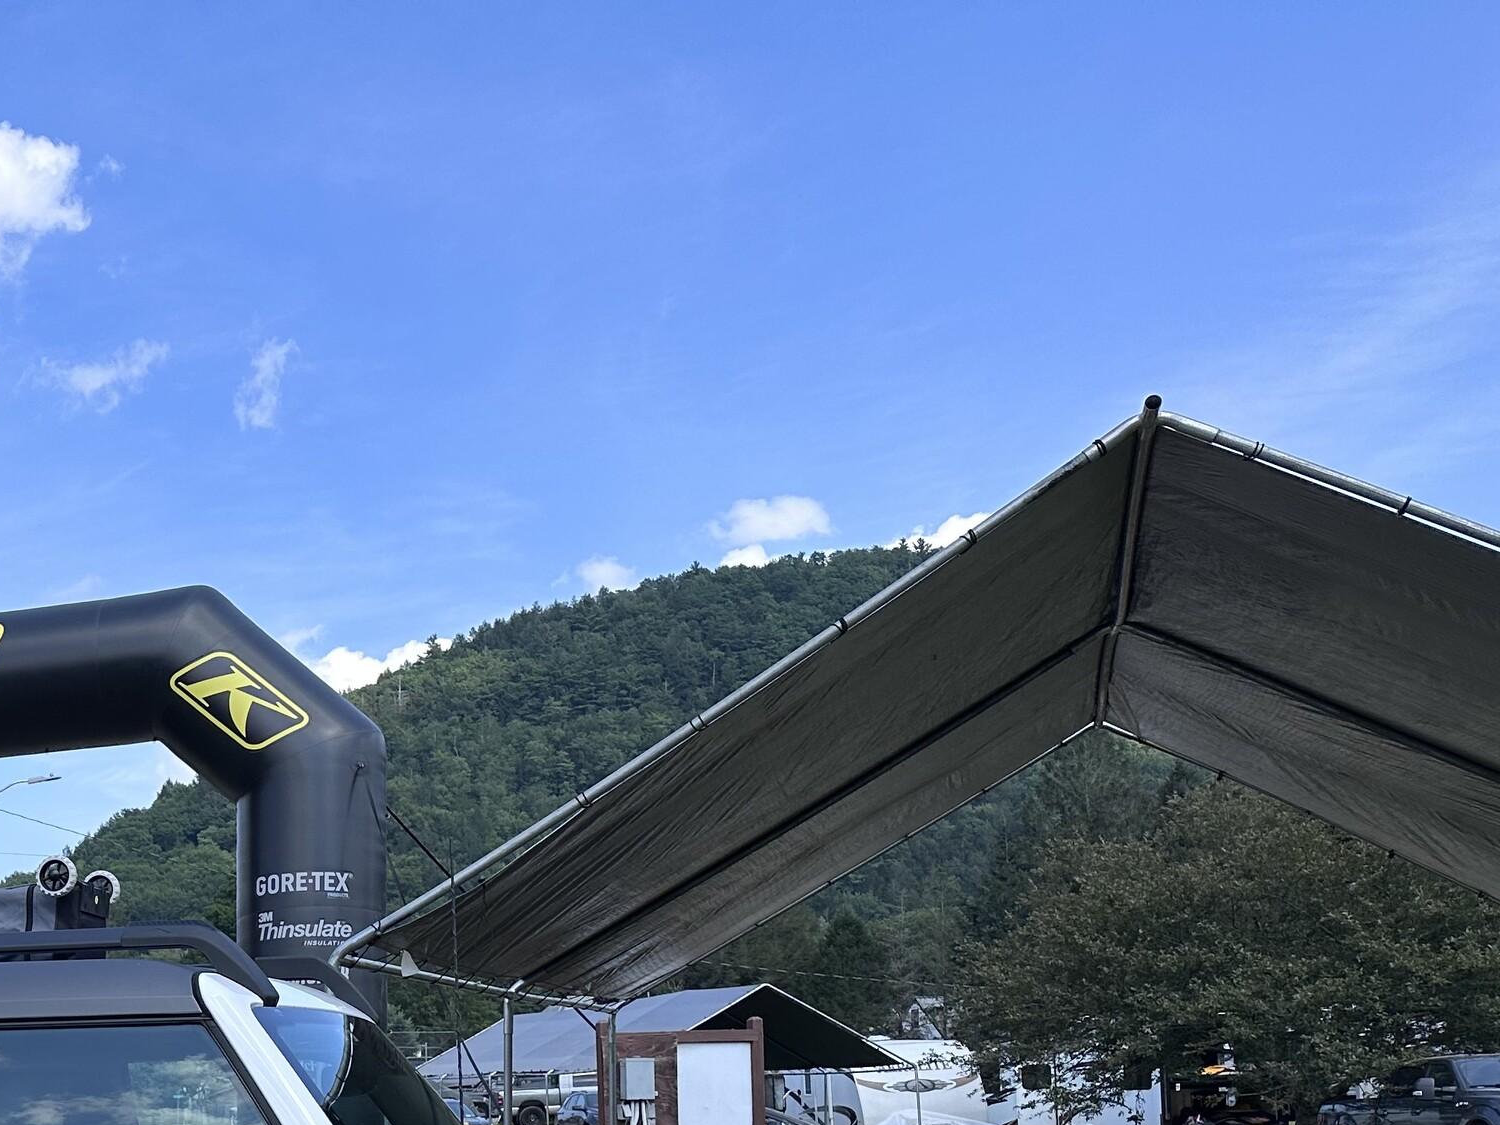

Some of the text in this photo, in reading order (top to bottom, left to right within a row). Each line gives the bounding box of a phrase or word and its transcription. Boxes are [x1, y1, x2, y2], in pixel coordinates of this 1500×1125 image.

[178, 665, 299, 737] K
[256, 871, 349, 896] GORE-TEX
[259, 912, 273, 922] 3M
[258, 920, 353, 941] Thinsulate
